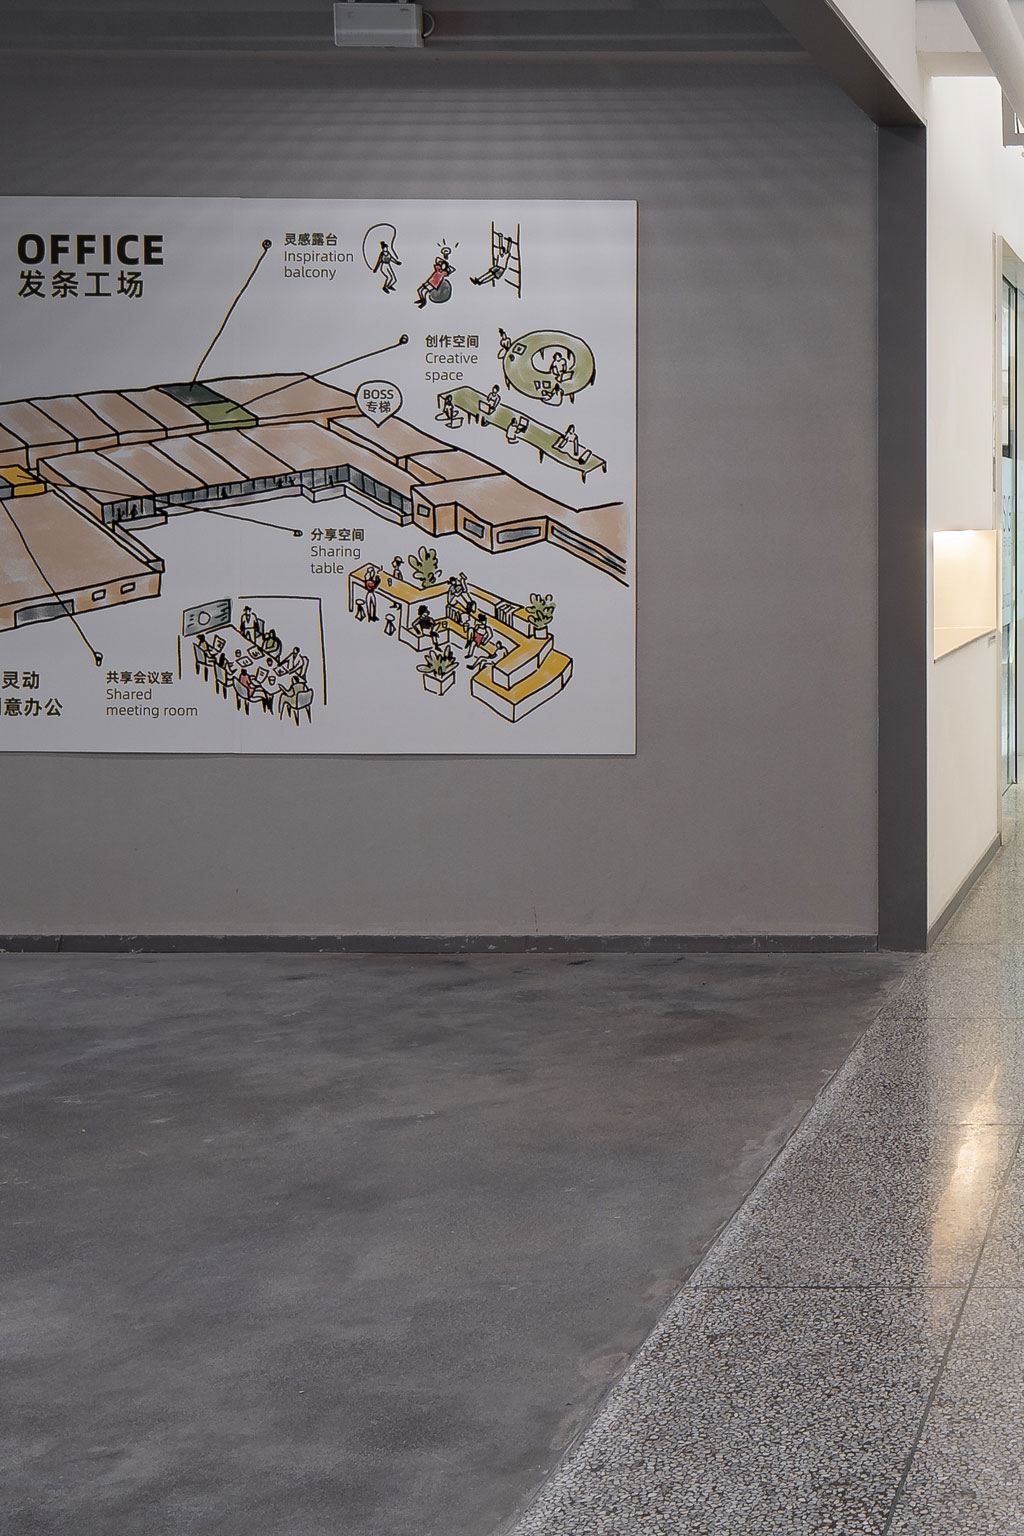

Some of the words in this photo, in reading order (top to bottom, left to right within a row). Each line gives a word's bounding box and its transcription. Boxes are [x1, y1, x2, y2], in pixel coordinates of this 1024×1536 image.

[284, 232, 338, 246] 灵感露台
[17, 234, 165, 265] OFFICE
[284, 250, 354, 264] Inspiration
[284, 266, 337, 280] balcony
[18, 270, 144, 299] 发条工场
[425, 334, 479, 348] 创作空间
[425, 352, 479, 364] Creative
[425, 371, 464, 383] space
[363, 389, 394, 400] BOSS
[365, 400, 391, 414] 专梯
[310, 528, 365, 542] 分享空间
[310, 545, 361, 560] Sharing
[310, 562, 344, 574] table
[1, 670, 40, 690] 灵动
[106, 670, 174, 685] 共享会议室
[106, 688, 152, 700] Shared
[0, 697, 64, 716] 意办公
[106, 704, 159, 719] meeting
[163, 707, 198, 717] room
